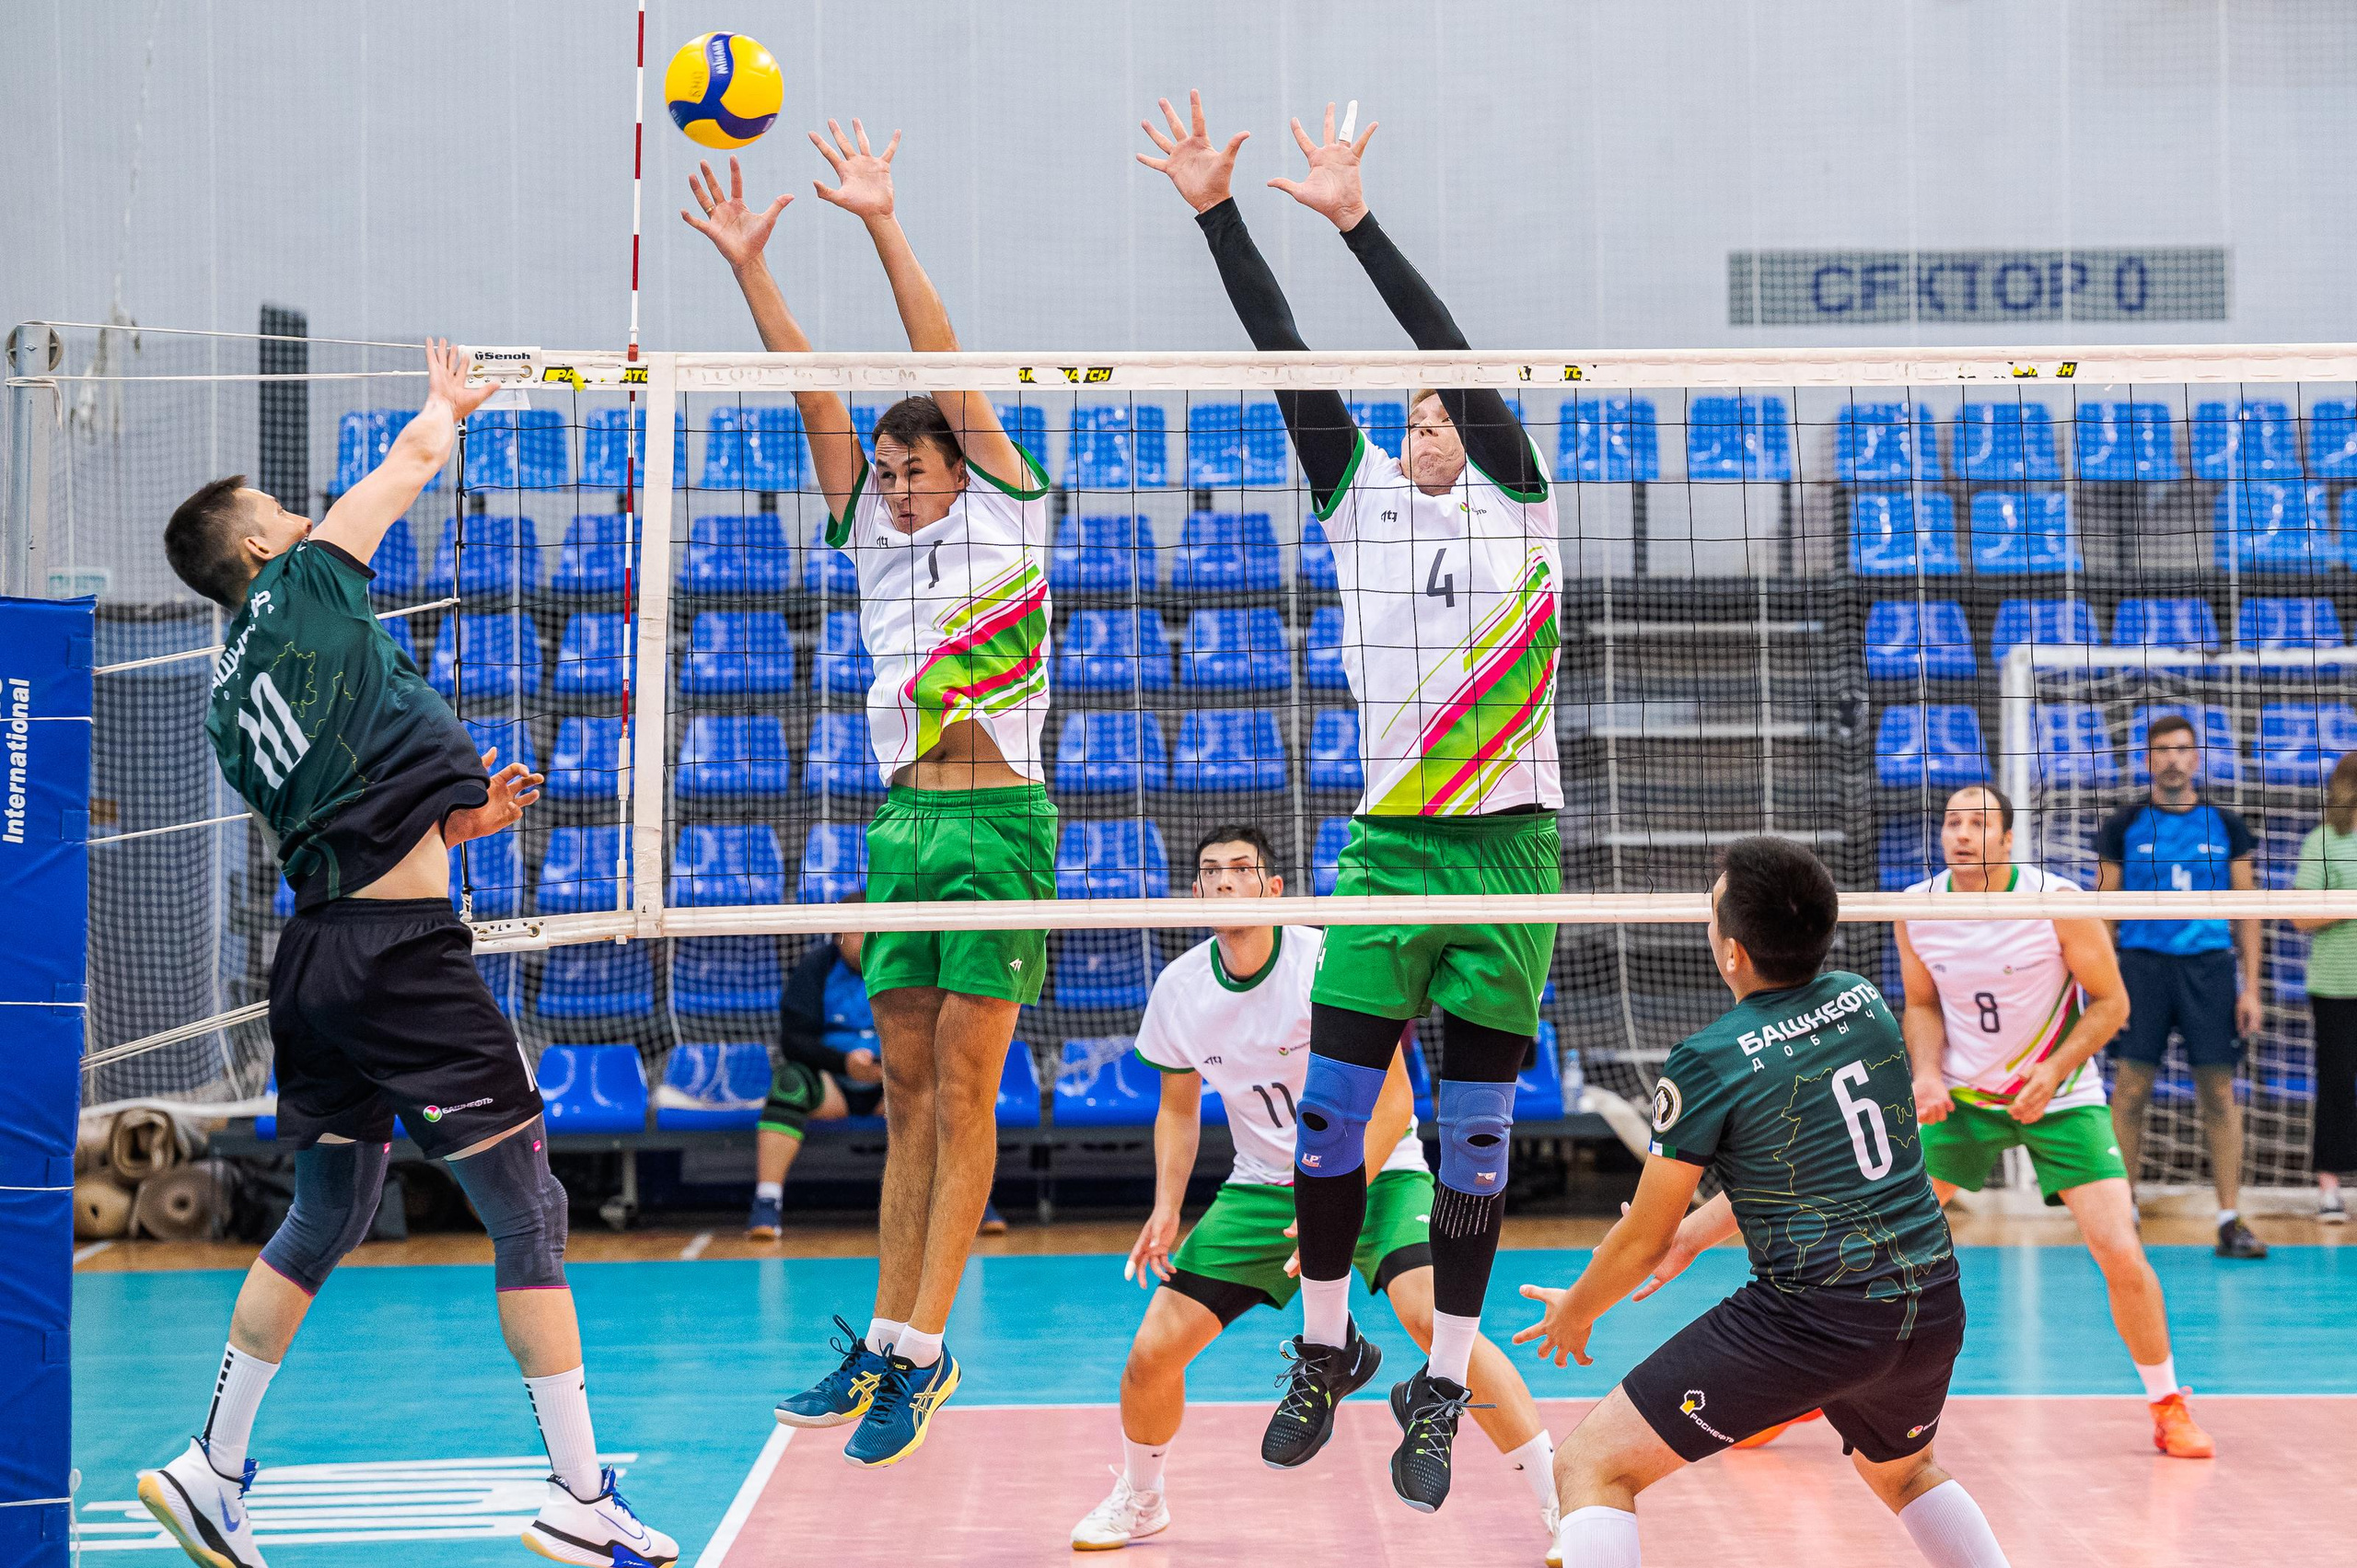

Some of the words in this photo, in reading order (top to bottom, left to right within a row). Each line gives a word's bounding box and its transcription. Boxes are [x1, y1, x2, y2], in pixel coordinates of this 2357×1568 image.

[484, 352, 531, 360] Senoh
[1426, 547, 1456, 609] 4
[3, 678, 30, 844] International
[1736, 982, 1879, 1057] БАШНЕФТЬ
[1974, 992, 2001, 1033] 8
[1252, 1082, 1297, 1129] 11
[1831, 1059, 1893, 1181] 6
[1303, 1152, 1320, 1164] LP
[1689, 1412, 1735, 1443] РОСНЕФТЬ
